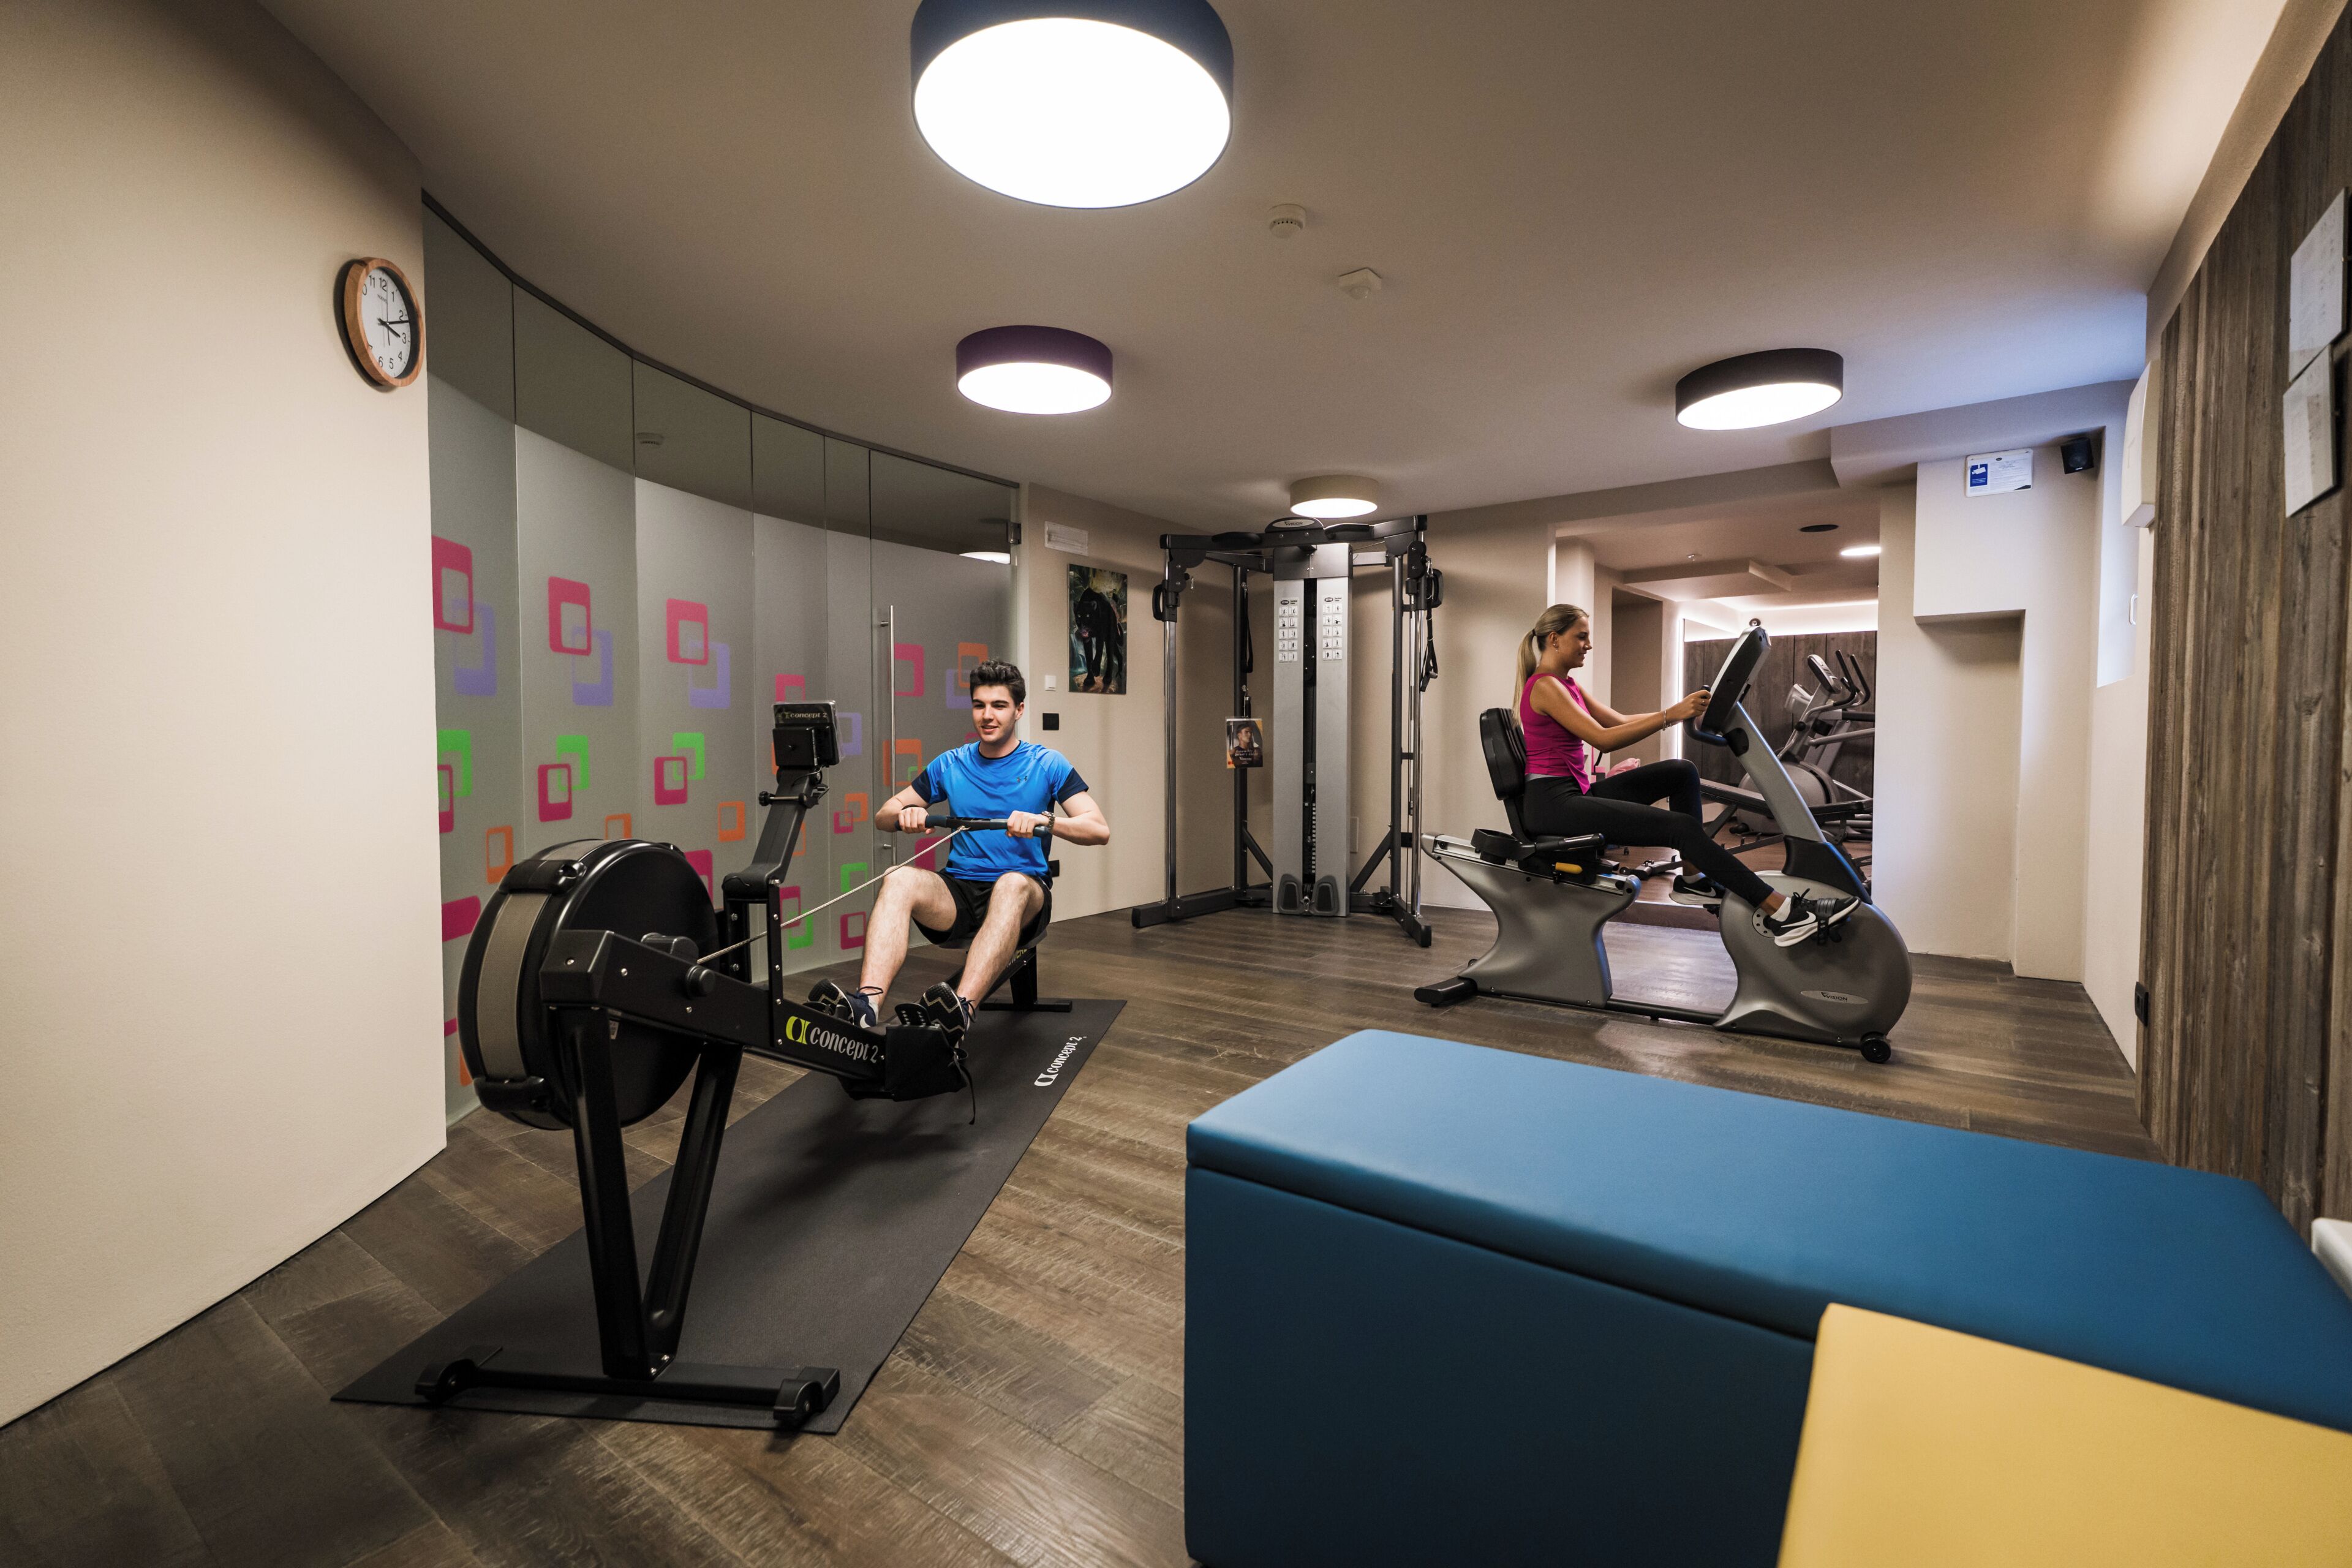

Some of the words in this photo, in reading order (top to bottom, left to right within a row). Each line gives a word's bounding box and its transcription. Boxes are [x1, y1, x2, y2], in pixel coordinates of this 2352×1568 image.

[369, 274, 375, 288] 11
[379, 277, 387, 292] 12
[363, 284, 368, 296] 0
[391, 291, 394, 303] 1
[399, 309, 404, 322] 2
[402, 332, 407, 344] 3
[379, 356, 383, 368] 6
[398, 351, 402, 362] 4
[389, 358, 394, 369] 5
[810, 1027, 869, 1060] concept
[870, 1045, 878, 1063] 2
[1047, 1042, 1078, 1073] concept
